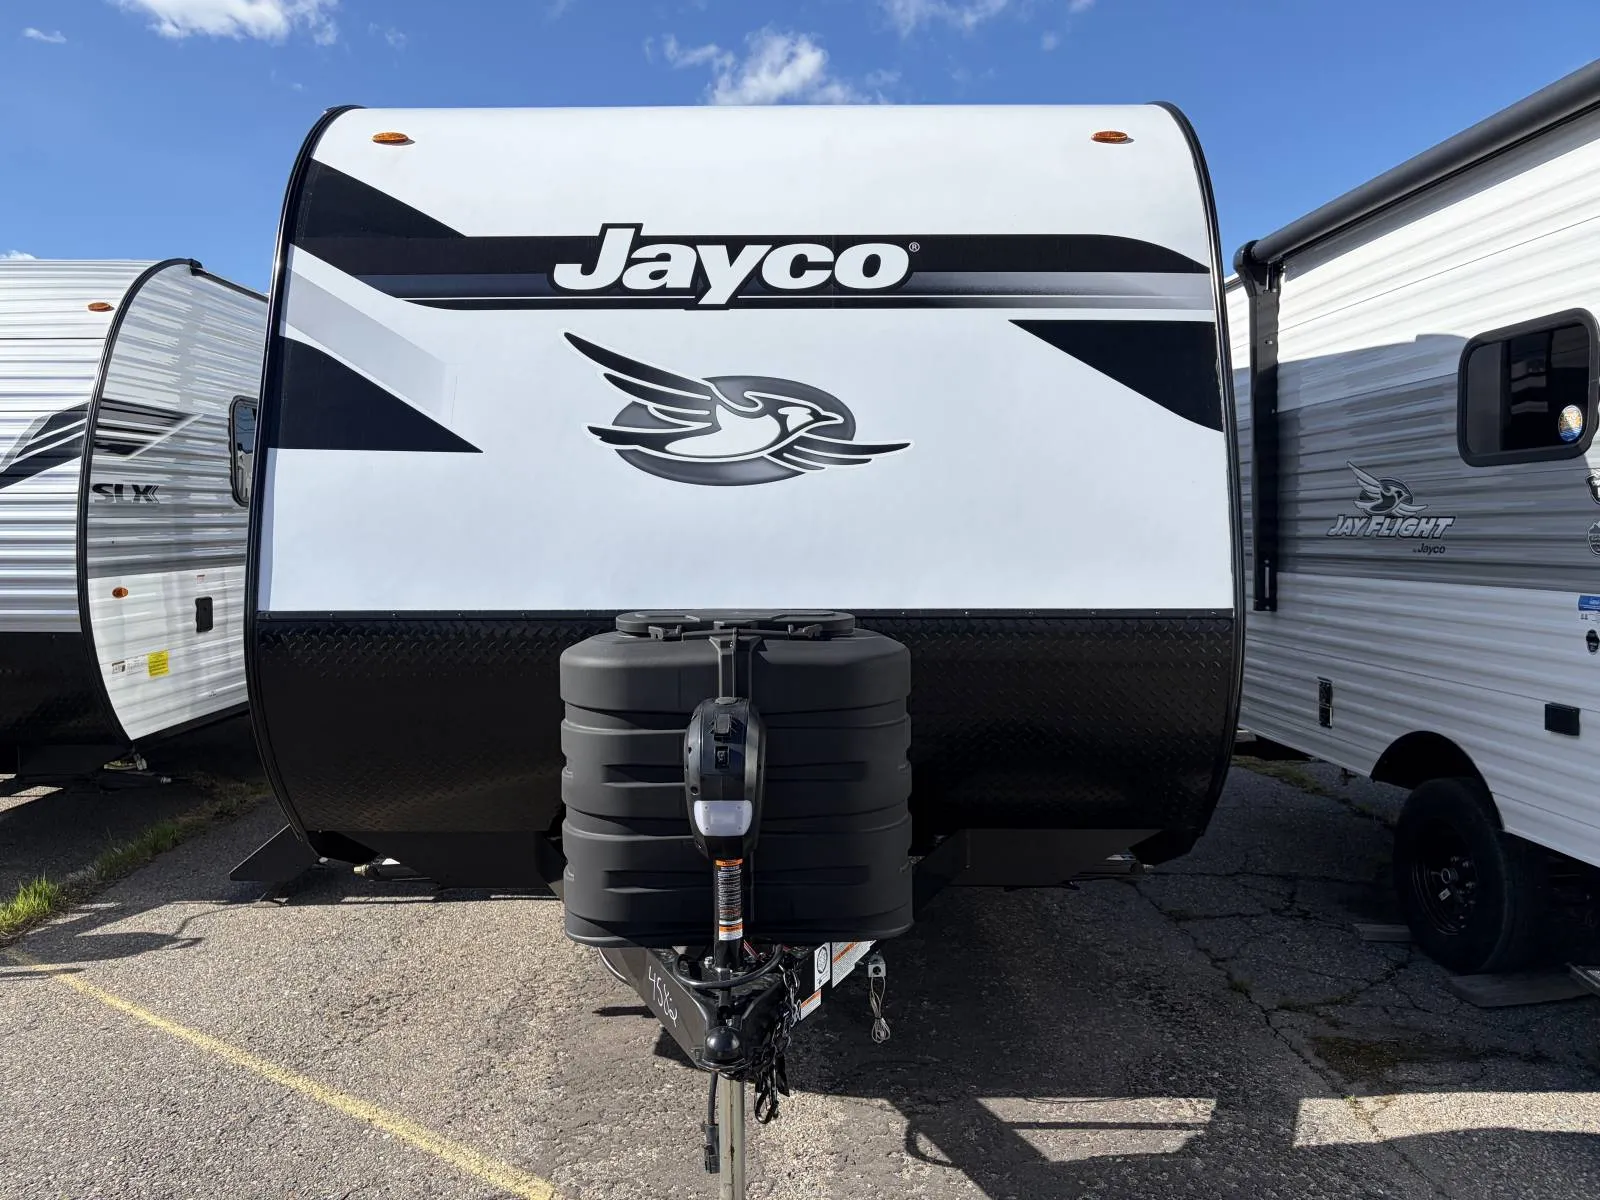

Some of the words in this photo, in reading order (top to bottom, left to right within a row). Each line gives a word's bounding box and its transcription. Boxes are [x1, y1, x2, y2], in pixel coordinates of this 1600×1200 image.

[1327, 514, 1367, 537] JAY
[1366, 515, 1455, 539] FLIGHT
[1417, 543, 1446, 556] Jayco
